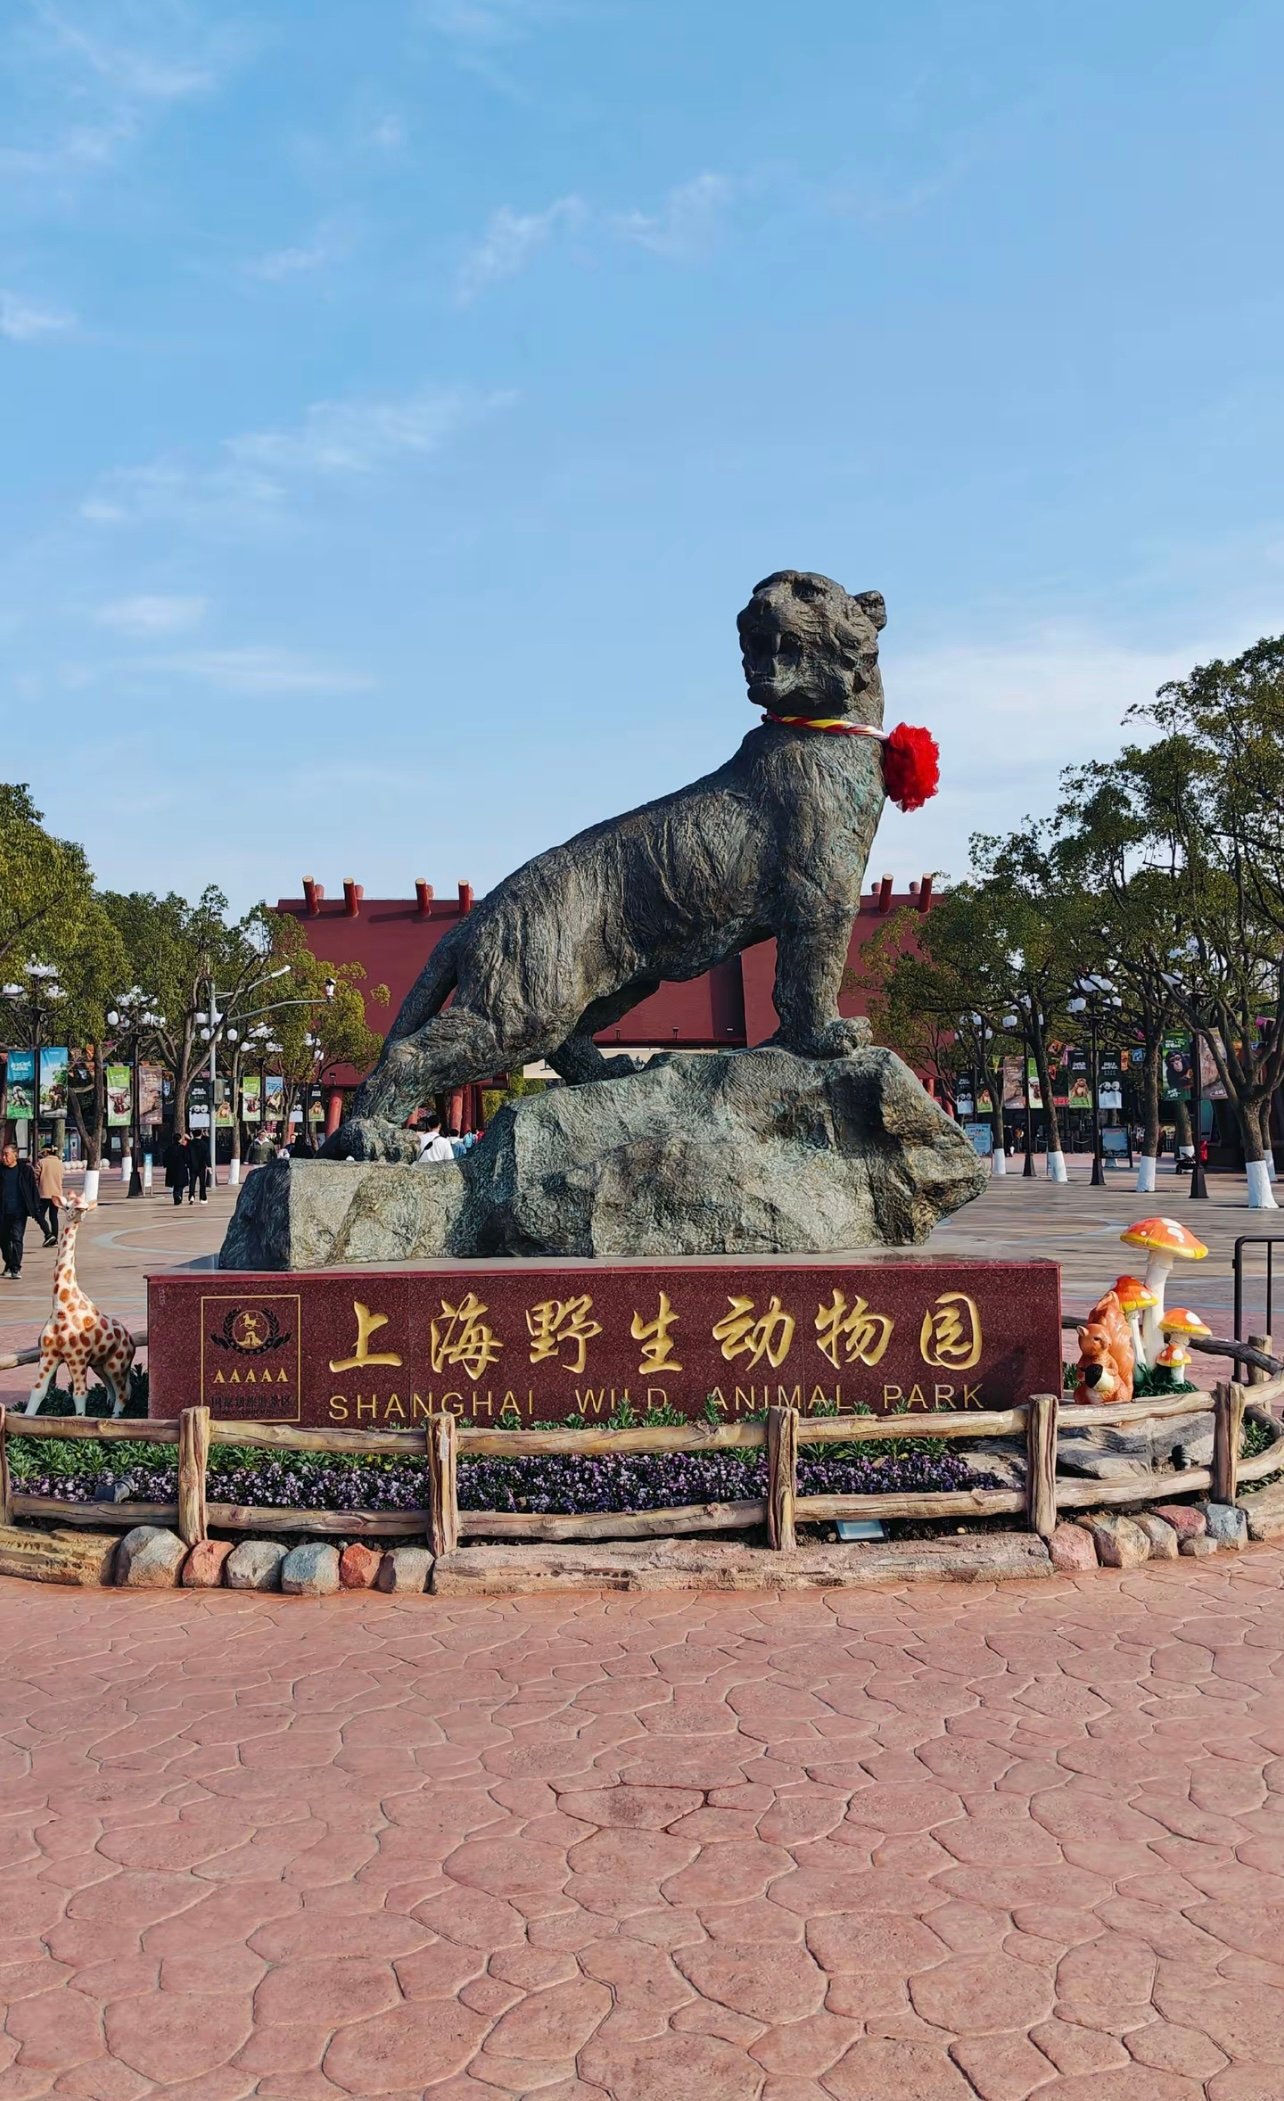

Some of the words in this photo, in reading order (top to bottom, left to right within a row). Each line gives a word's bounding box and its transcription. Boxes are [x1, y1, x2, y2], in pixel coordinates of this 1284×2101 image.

[329, 1287, 983, 1381] 上海野生动物园
[212, 1367, 289, 1384] AAAAA
[328, 1389, 534, 1420] SHANGHAI
[708, 1384, 853, 1411] ANIMAL
[882, 1383, 985, 1409] PARK
